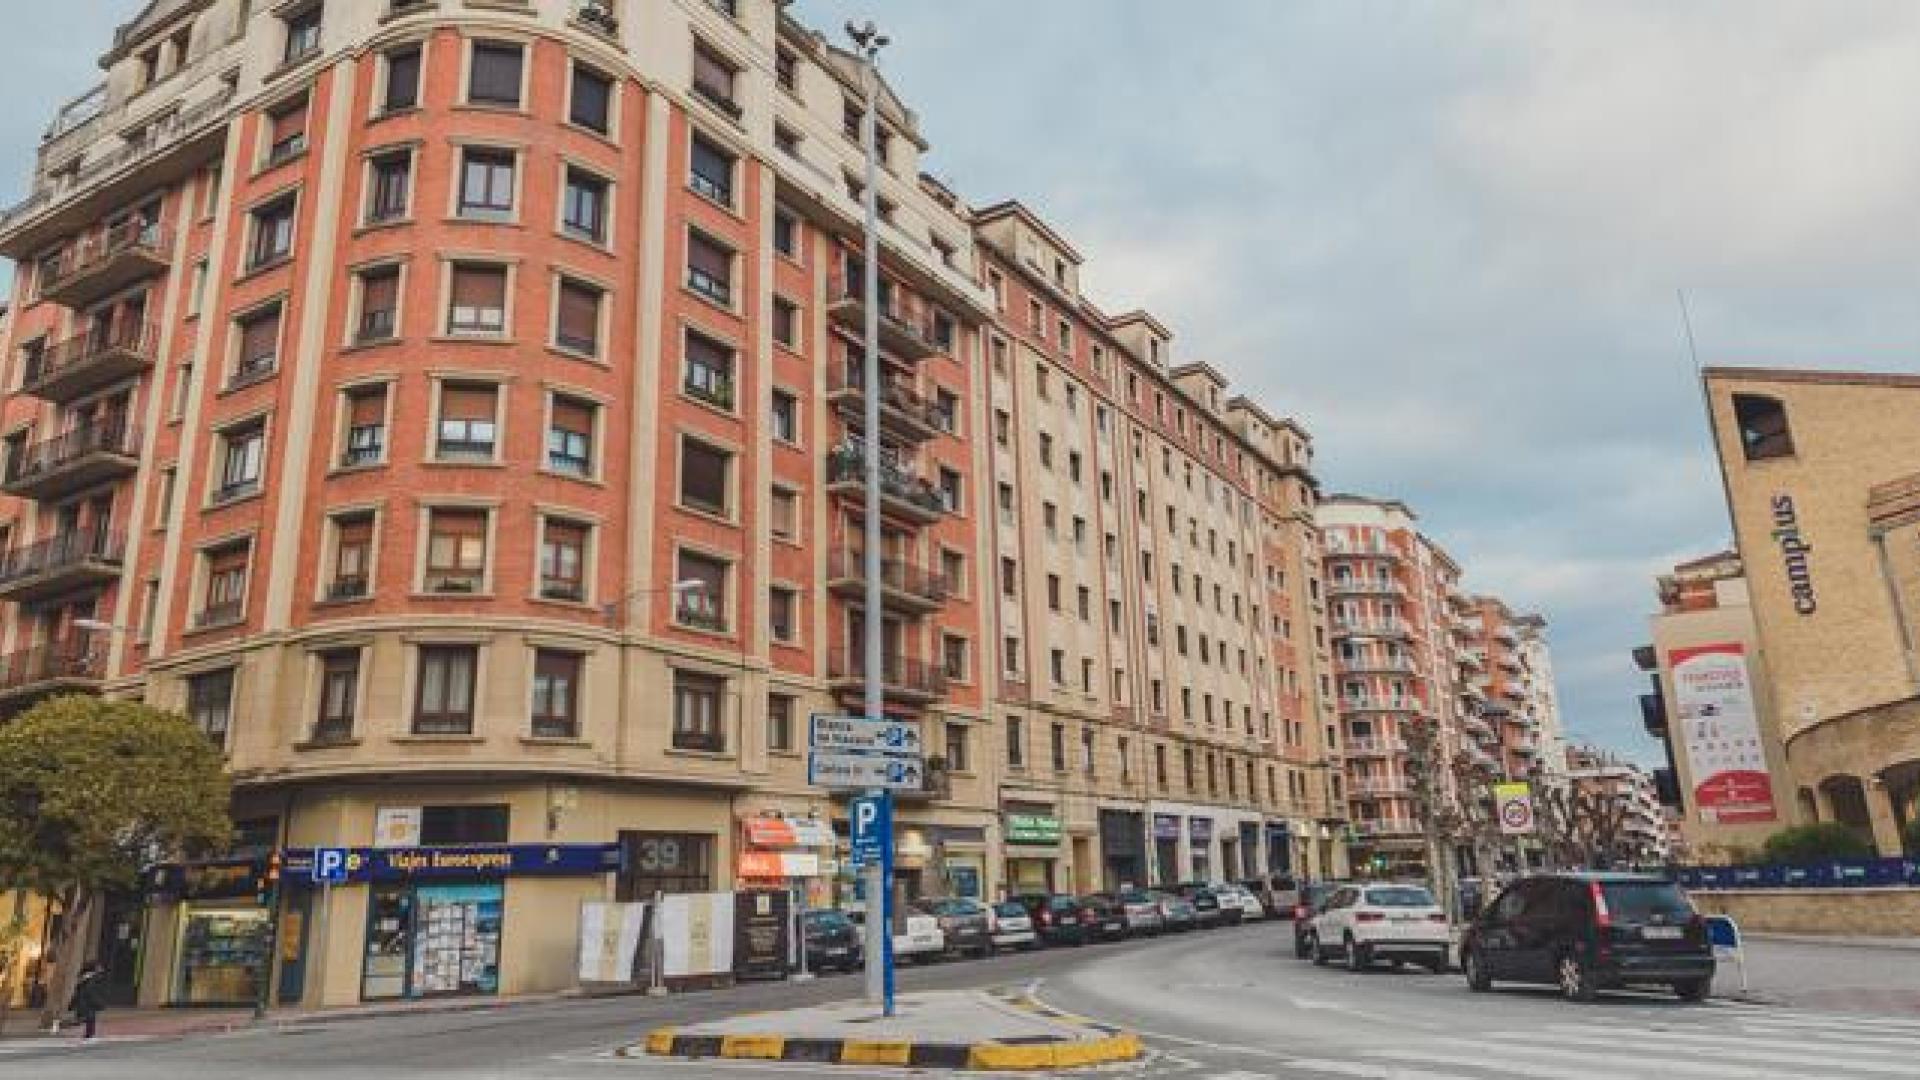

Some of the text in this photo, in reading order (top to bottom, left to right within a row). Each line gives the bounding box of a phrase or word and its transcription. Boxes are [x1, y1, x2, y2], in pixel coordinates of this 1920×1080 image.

[1773, 494, 1817, 615] camplus
[858, 802, 877, 836] P
[320, 850, 342, 877] P
[640, 838, 680, 871] 39
